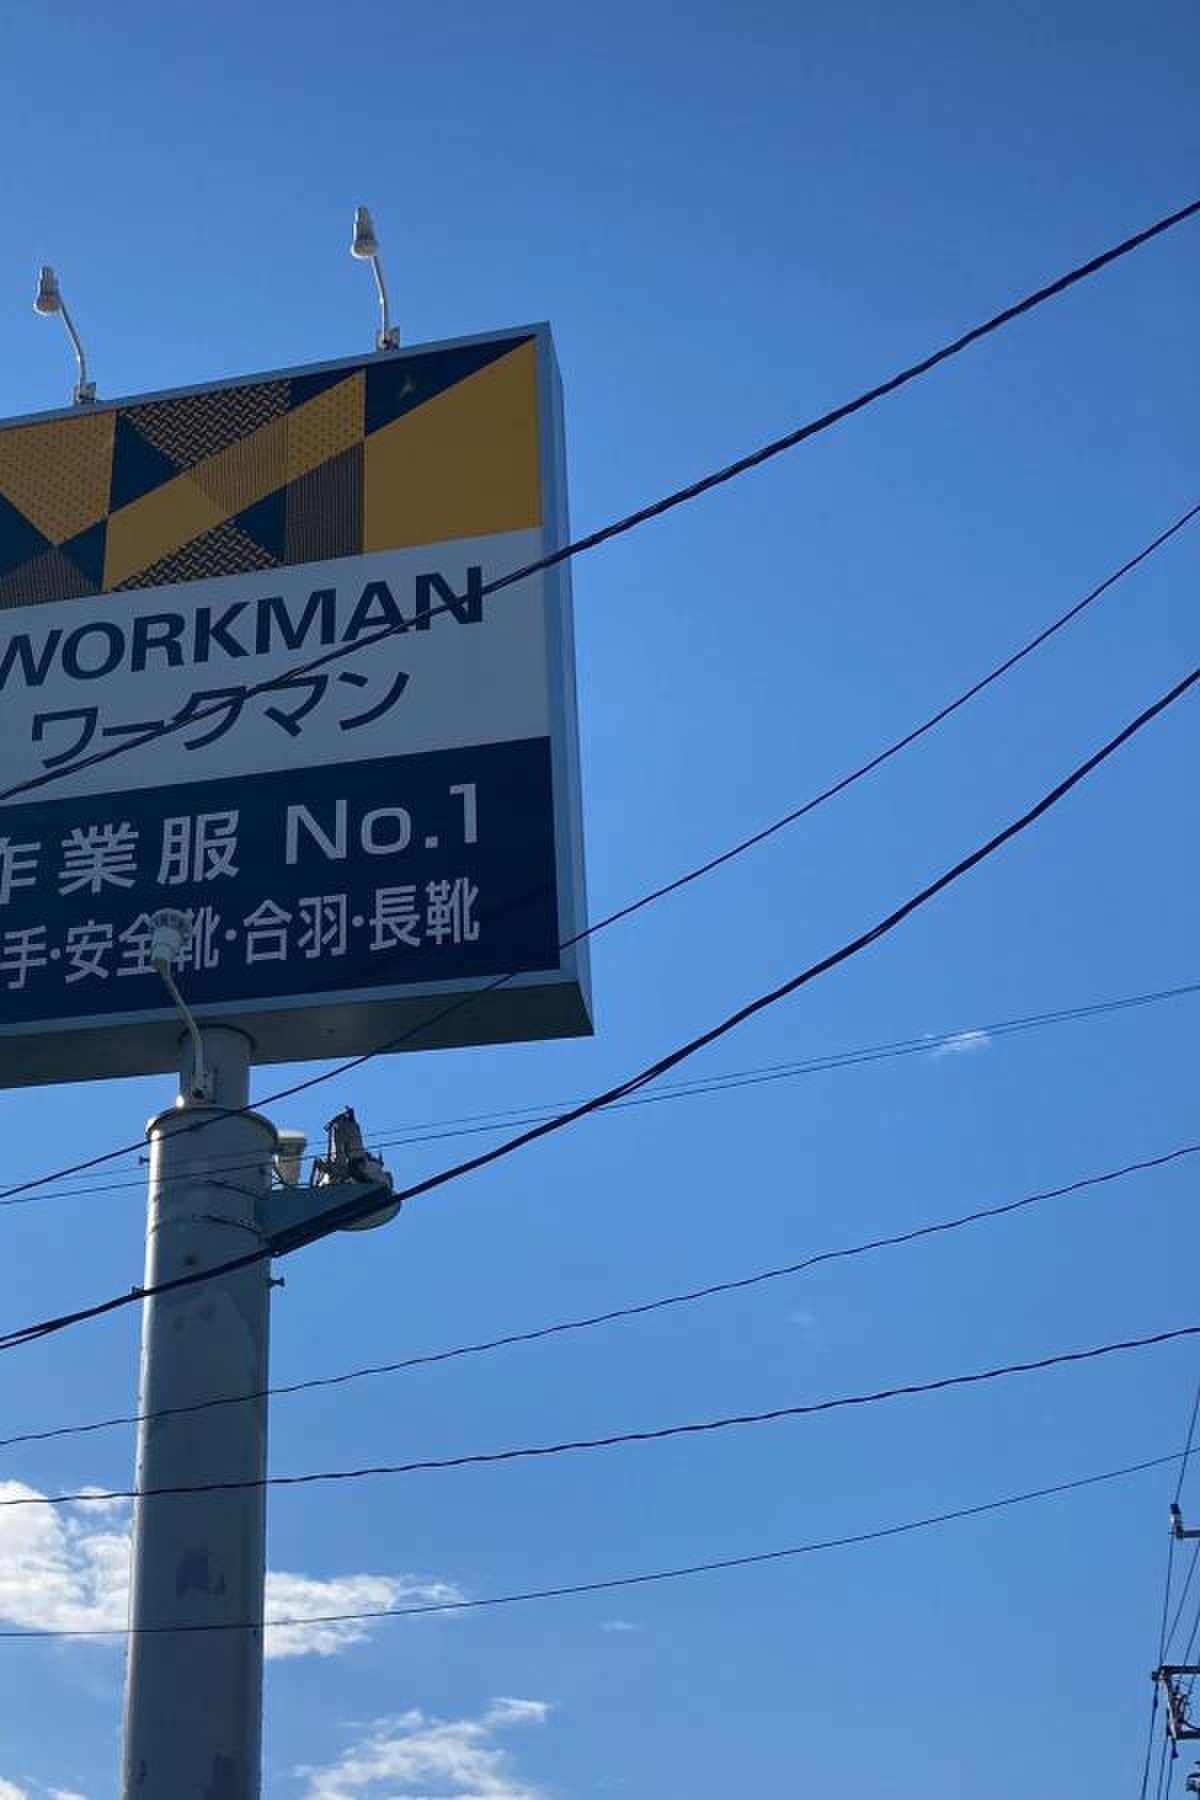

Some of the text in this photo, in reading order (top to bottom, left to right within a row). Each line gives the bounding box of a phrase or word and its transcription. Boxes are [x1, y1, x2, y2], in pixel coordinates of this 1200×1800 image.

[31, 671, 410, 769] ワークマン
[285, 783, 479, 865] No.1
